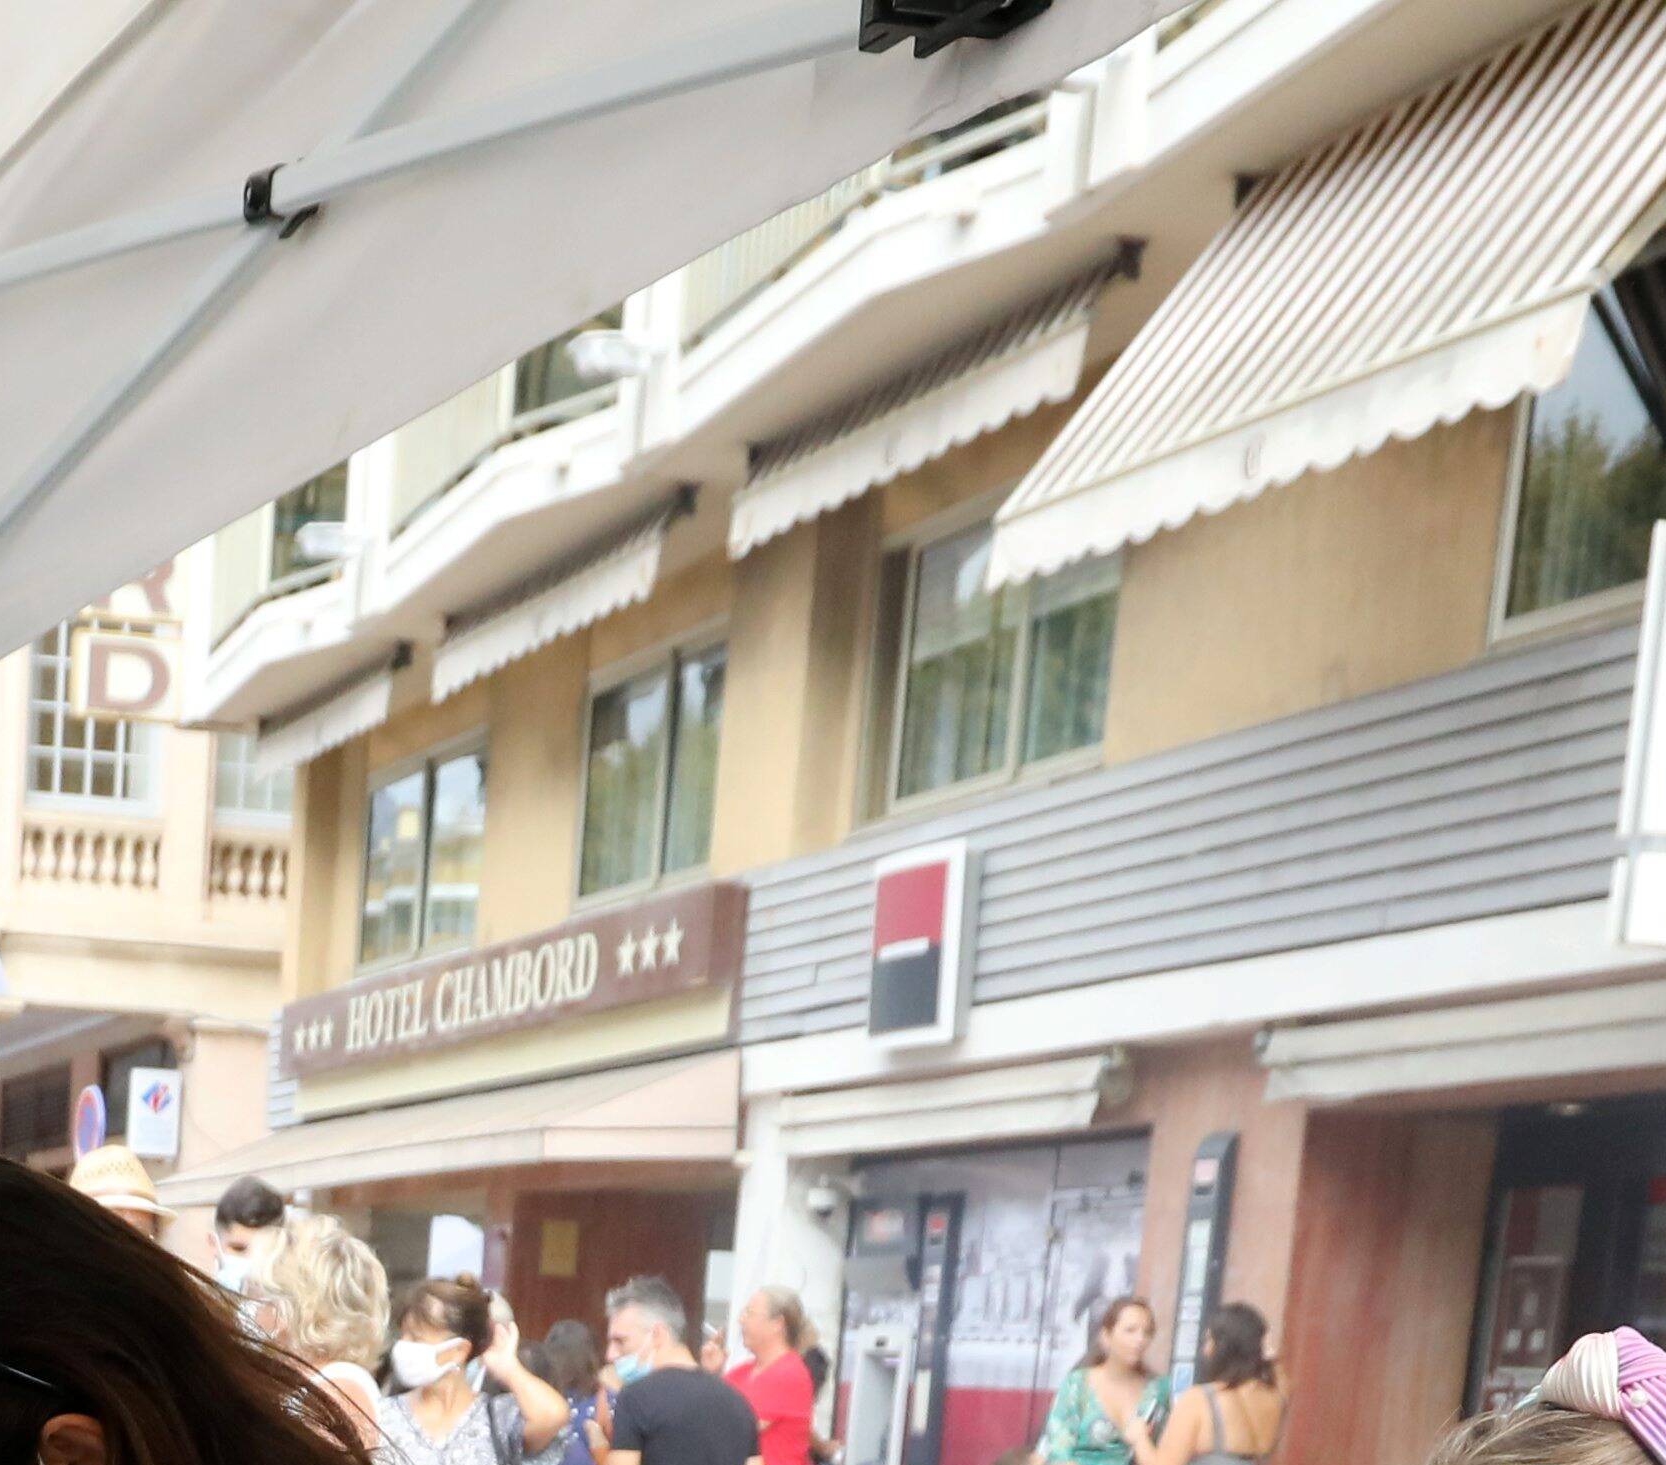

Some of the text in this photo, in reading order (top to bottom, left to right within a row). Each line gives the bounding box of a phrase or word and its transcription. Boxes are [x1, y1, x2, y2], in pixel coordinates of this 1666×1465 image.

[86, 641, 172, 713] D
[344, 931, 599, 1054] HOTEL CHAMBORD
